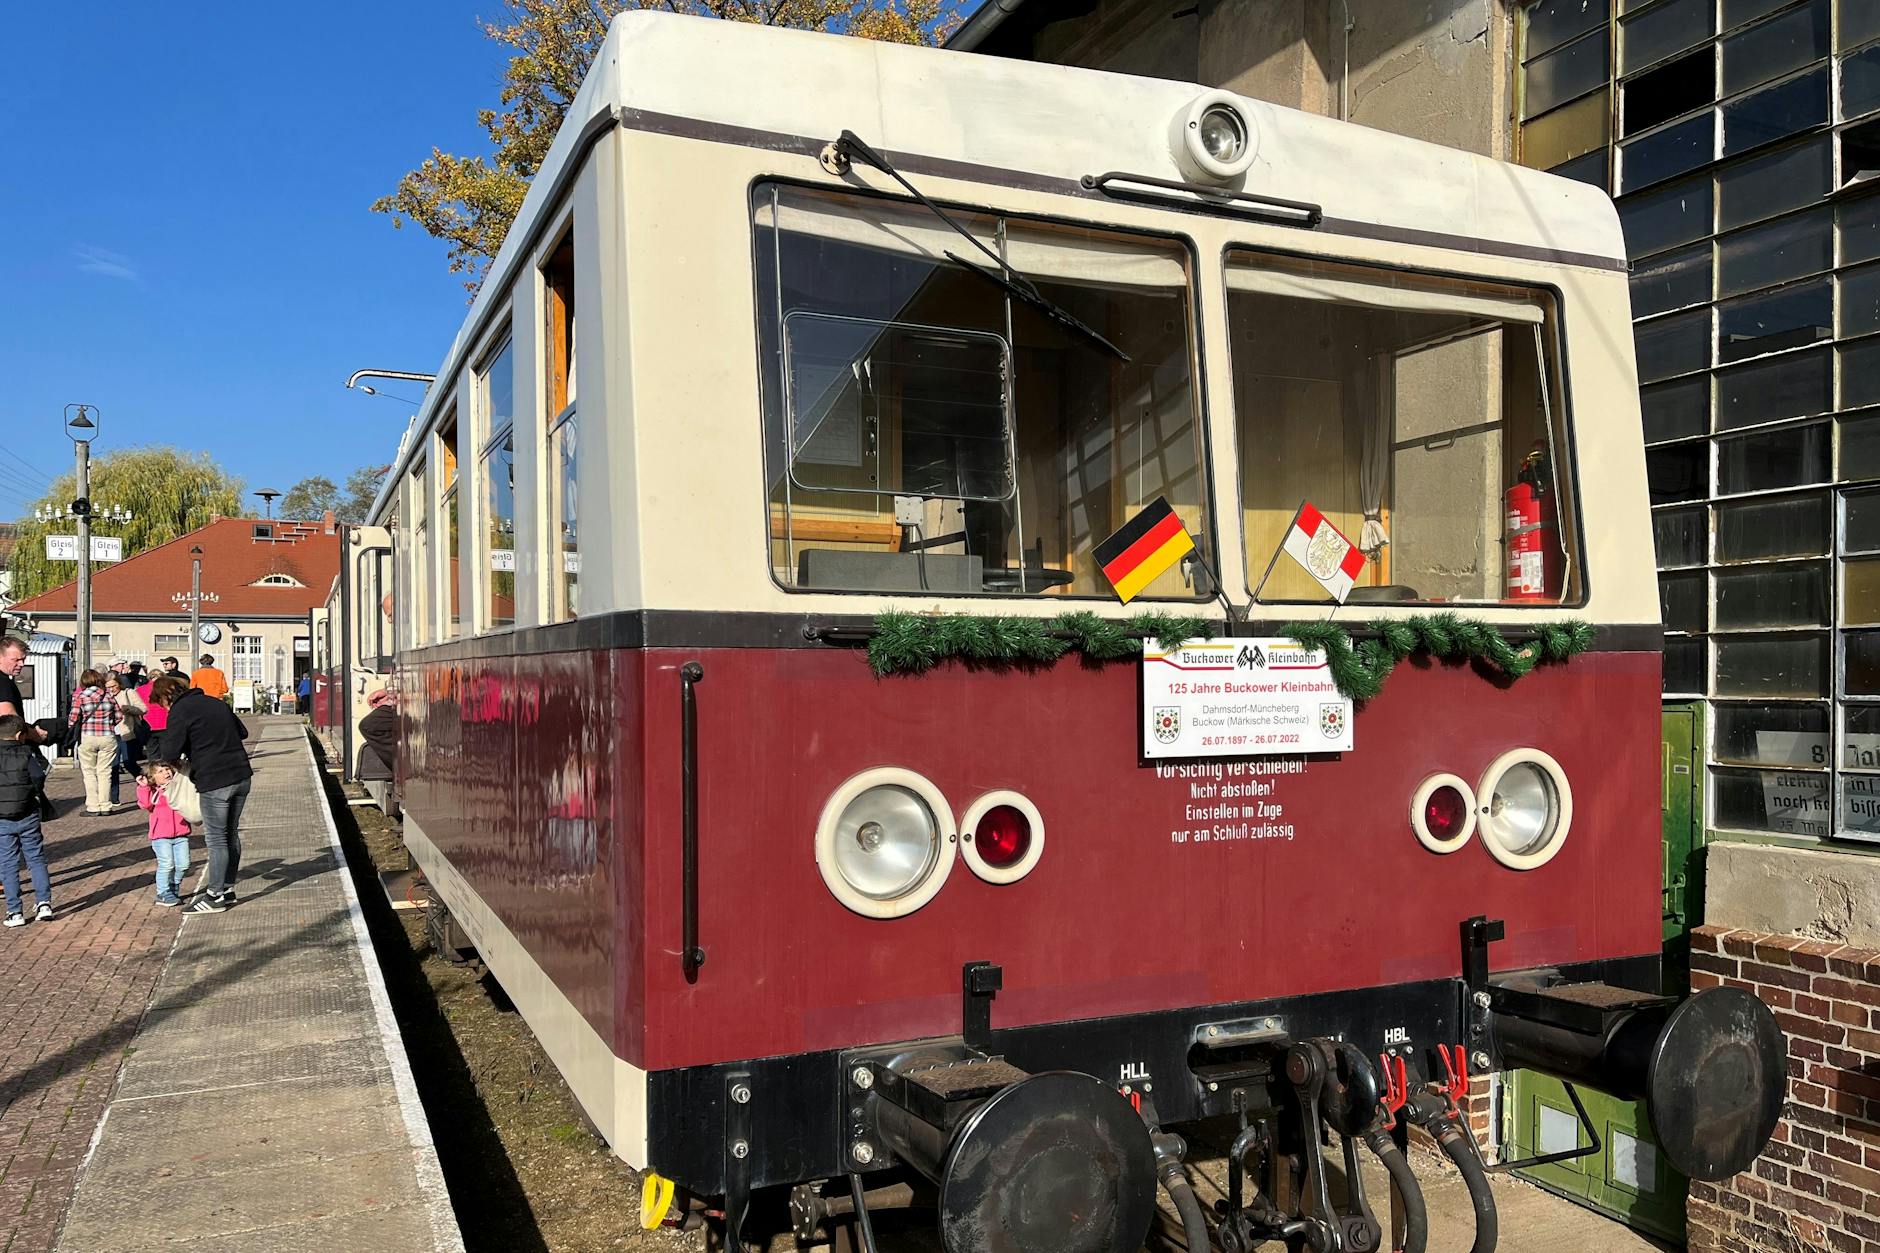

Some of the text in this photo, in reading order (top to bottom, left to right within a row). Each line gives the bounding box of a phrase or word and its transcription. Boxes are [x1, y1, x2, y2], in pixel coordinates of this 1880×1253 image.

[50, 540, 72, 548] Gleis
[97, 541, 118, 550] Gleis
[58, 548, 64, 556] 2
[1182, 652, 1317, 664] Buckower Kleinbahn
[1168, 682, 1334, 694] 125 Jahre Buckower Kleinbahn
[1202, 704, 1300, 715] Dahmsdorf-Müncheberg
[1192, 715, 1310, 728] Buckow (Märkische Schweiz)
[1202, 736, 1247, 746] 26.07.1897
[1255, 734, 1300, 744] 26.07.2022
[1812, 744, 1829, 764] 8
[1156, 754, 1308, 780] Vorsichtig verschieben!
[1190, 779, 1276, 799] Nicht abstoßen!
[1186, 801, 1282, 820] Einstellen im Zuge
[1773, 794, 1808, 812] noch
[1172, 822, 1294, 842] nur am Schluß zulässig
[1384, 1026, 1410, 1044] HBL
[1120, 1062, 1150, 1080] HLL
